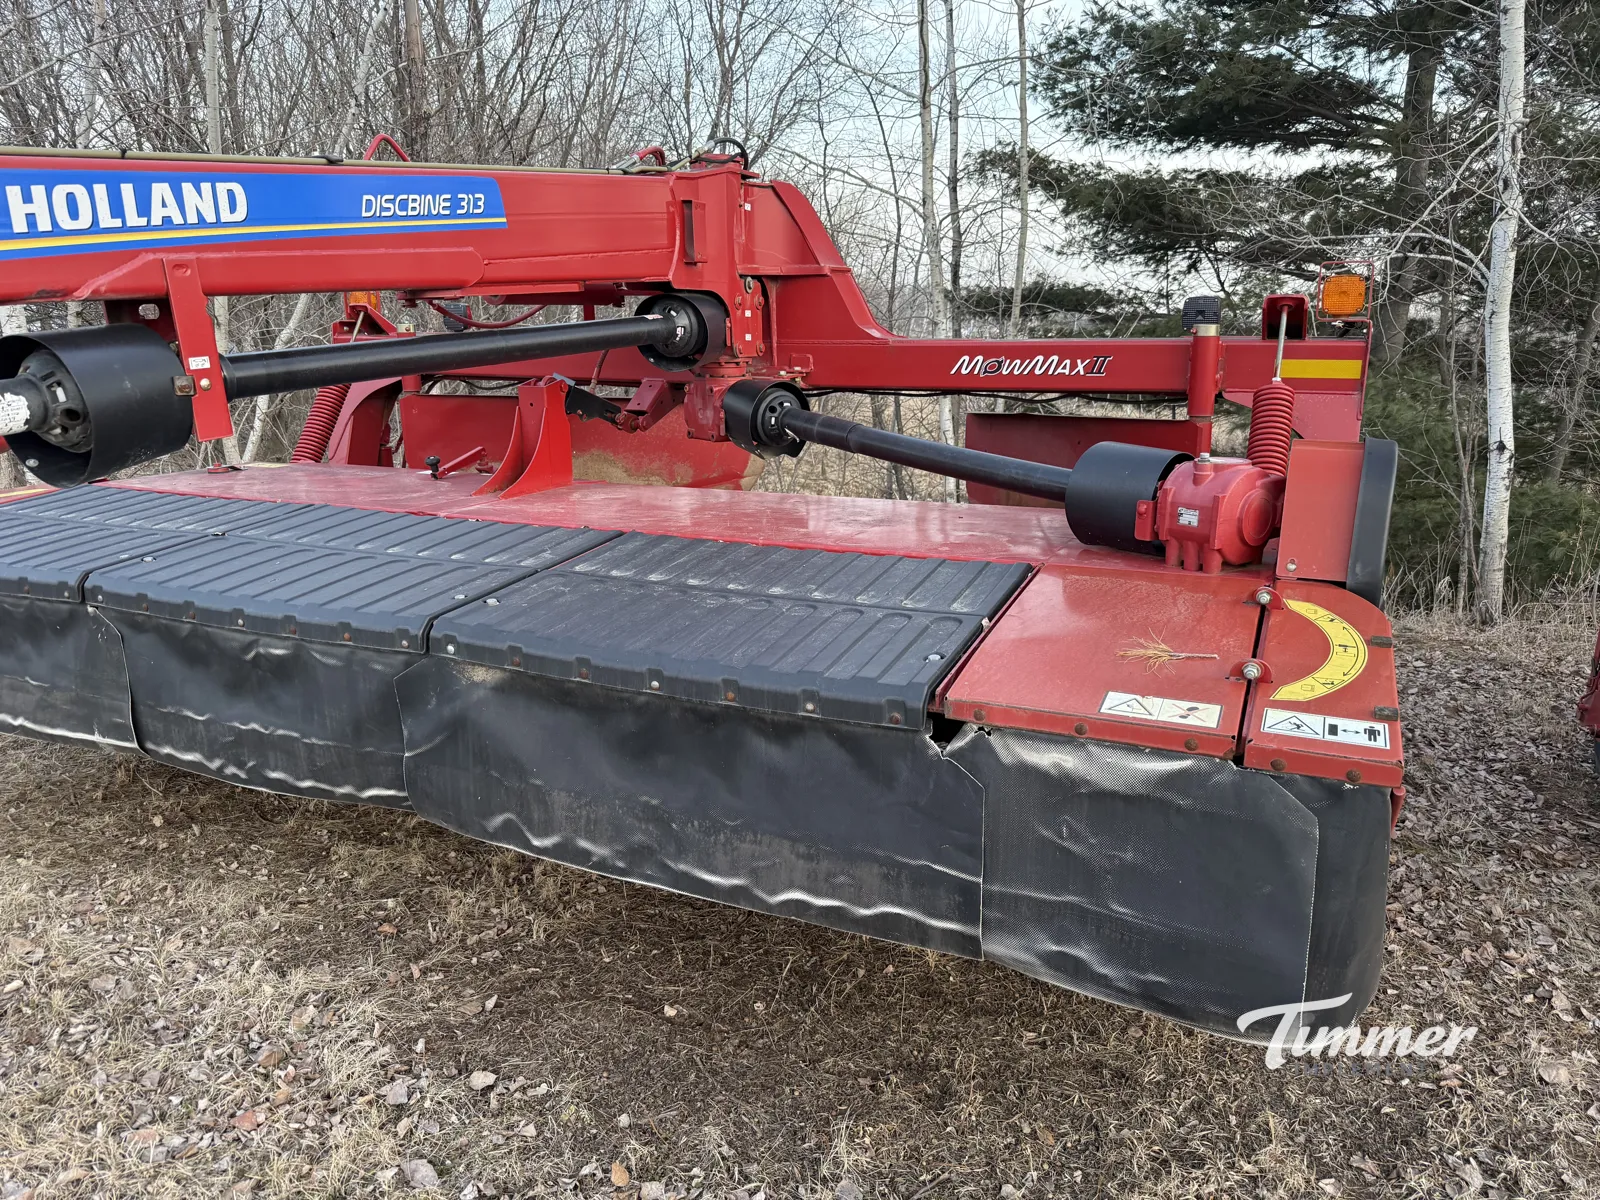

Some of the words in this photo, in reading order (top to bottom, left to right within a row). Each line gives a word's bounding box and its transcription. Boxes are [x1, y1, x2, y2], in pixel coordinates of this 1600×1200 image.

[5, 182, 248, 234] HOLLAND
[361, 194, 452, 218] DISCBINE
[456, 193, 485, 215] 313
